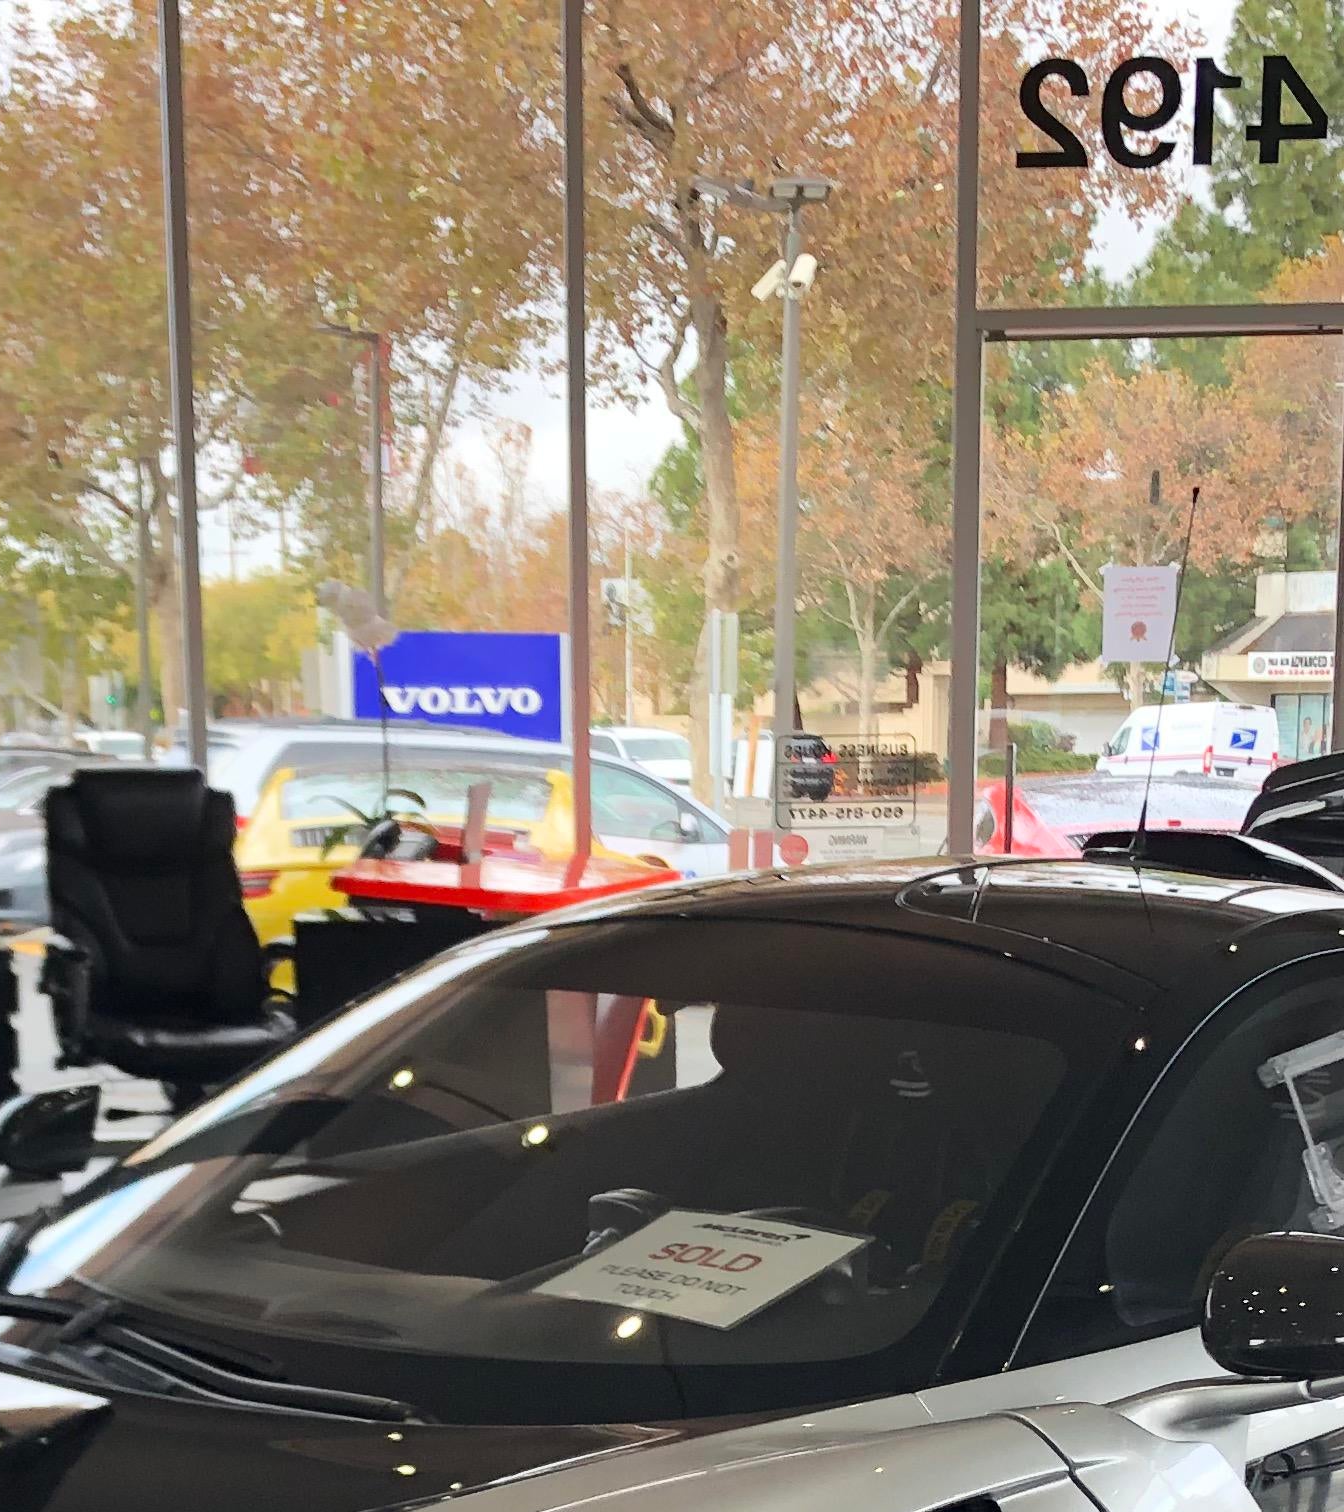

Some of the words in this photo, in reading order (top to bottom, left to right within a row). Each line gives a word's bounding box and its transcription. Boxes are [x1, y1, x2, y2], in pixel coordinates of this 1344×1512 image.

[380, 686, 543, 716] VOLVO
[648, 1242, 763, 1273] SOLD
[600, 1264, 672, 1281] PLEASE
[669, 1273, 701, 1287] DO
[699, 1279, 748, 1297] NOT
[615, 1282, 680, 1302] TOUCH
